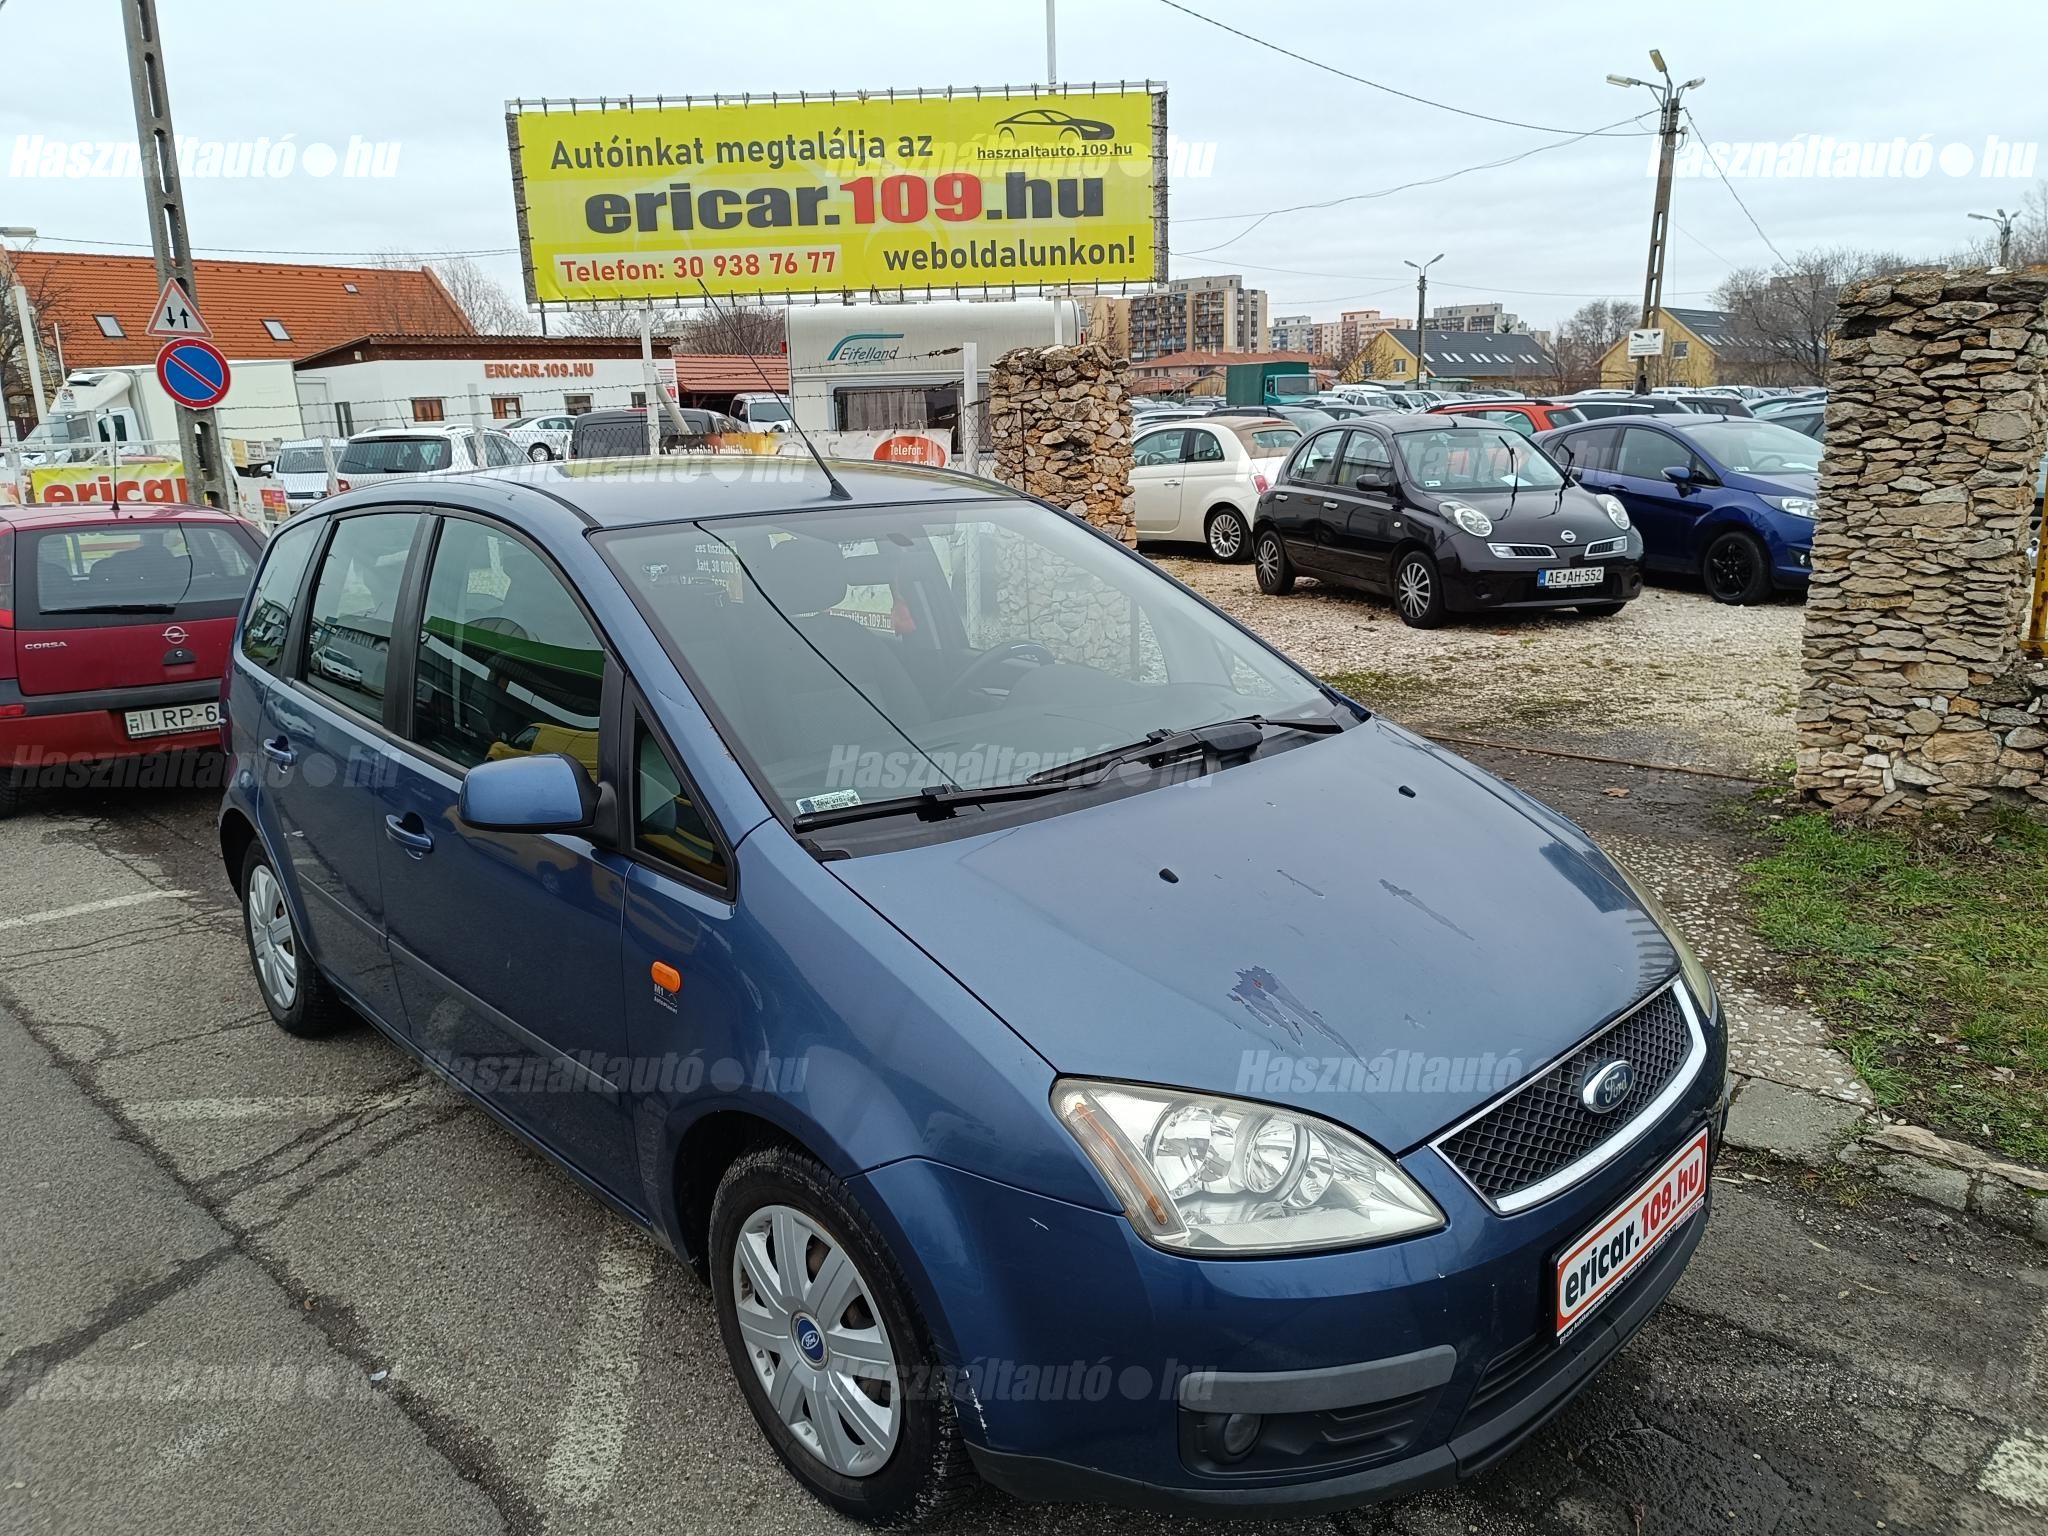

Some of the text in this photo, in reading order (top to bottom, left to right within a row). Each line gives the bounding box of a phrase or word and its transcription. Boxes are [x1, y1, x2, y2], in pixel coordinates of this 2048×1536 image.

[550, 127, 933, 171] Autóinkat megtalálja az
[976, 142, 1133, 161] hasznaltauto.109.hu
[585, 172, 1104, 235] ericar.109.hu
[560, 250, 836, 283] Telefon: 30 938 76 77
[883, 235, 1137, 273] weboldalunkon!
[484, 362, 595, 379] ERICAR.109.HU
[839, 345, 901, 362] Eifelland
[24, 641, 68, 650] CORSA
[1603, 1069, 1628, 1104] Ford
[1563, 1156, 1700, 1308] ericar.109.hu
